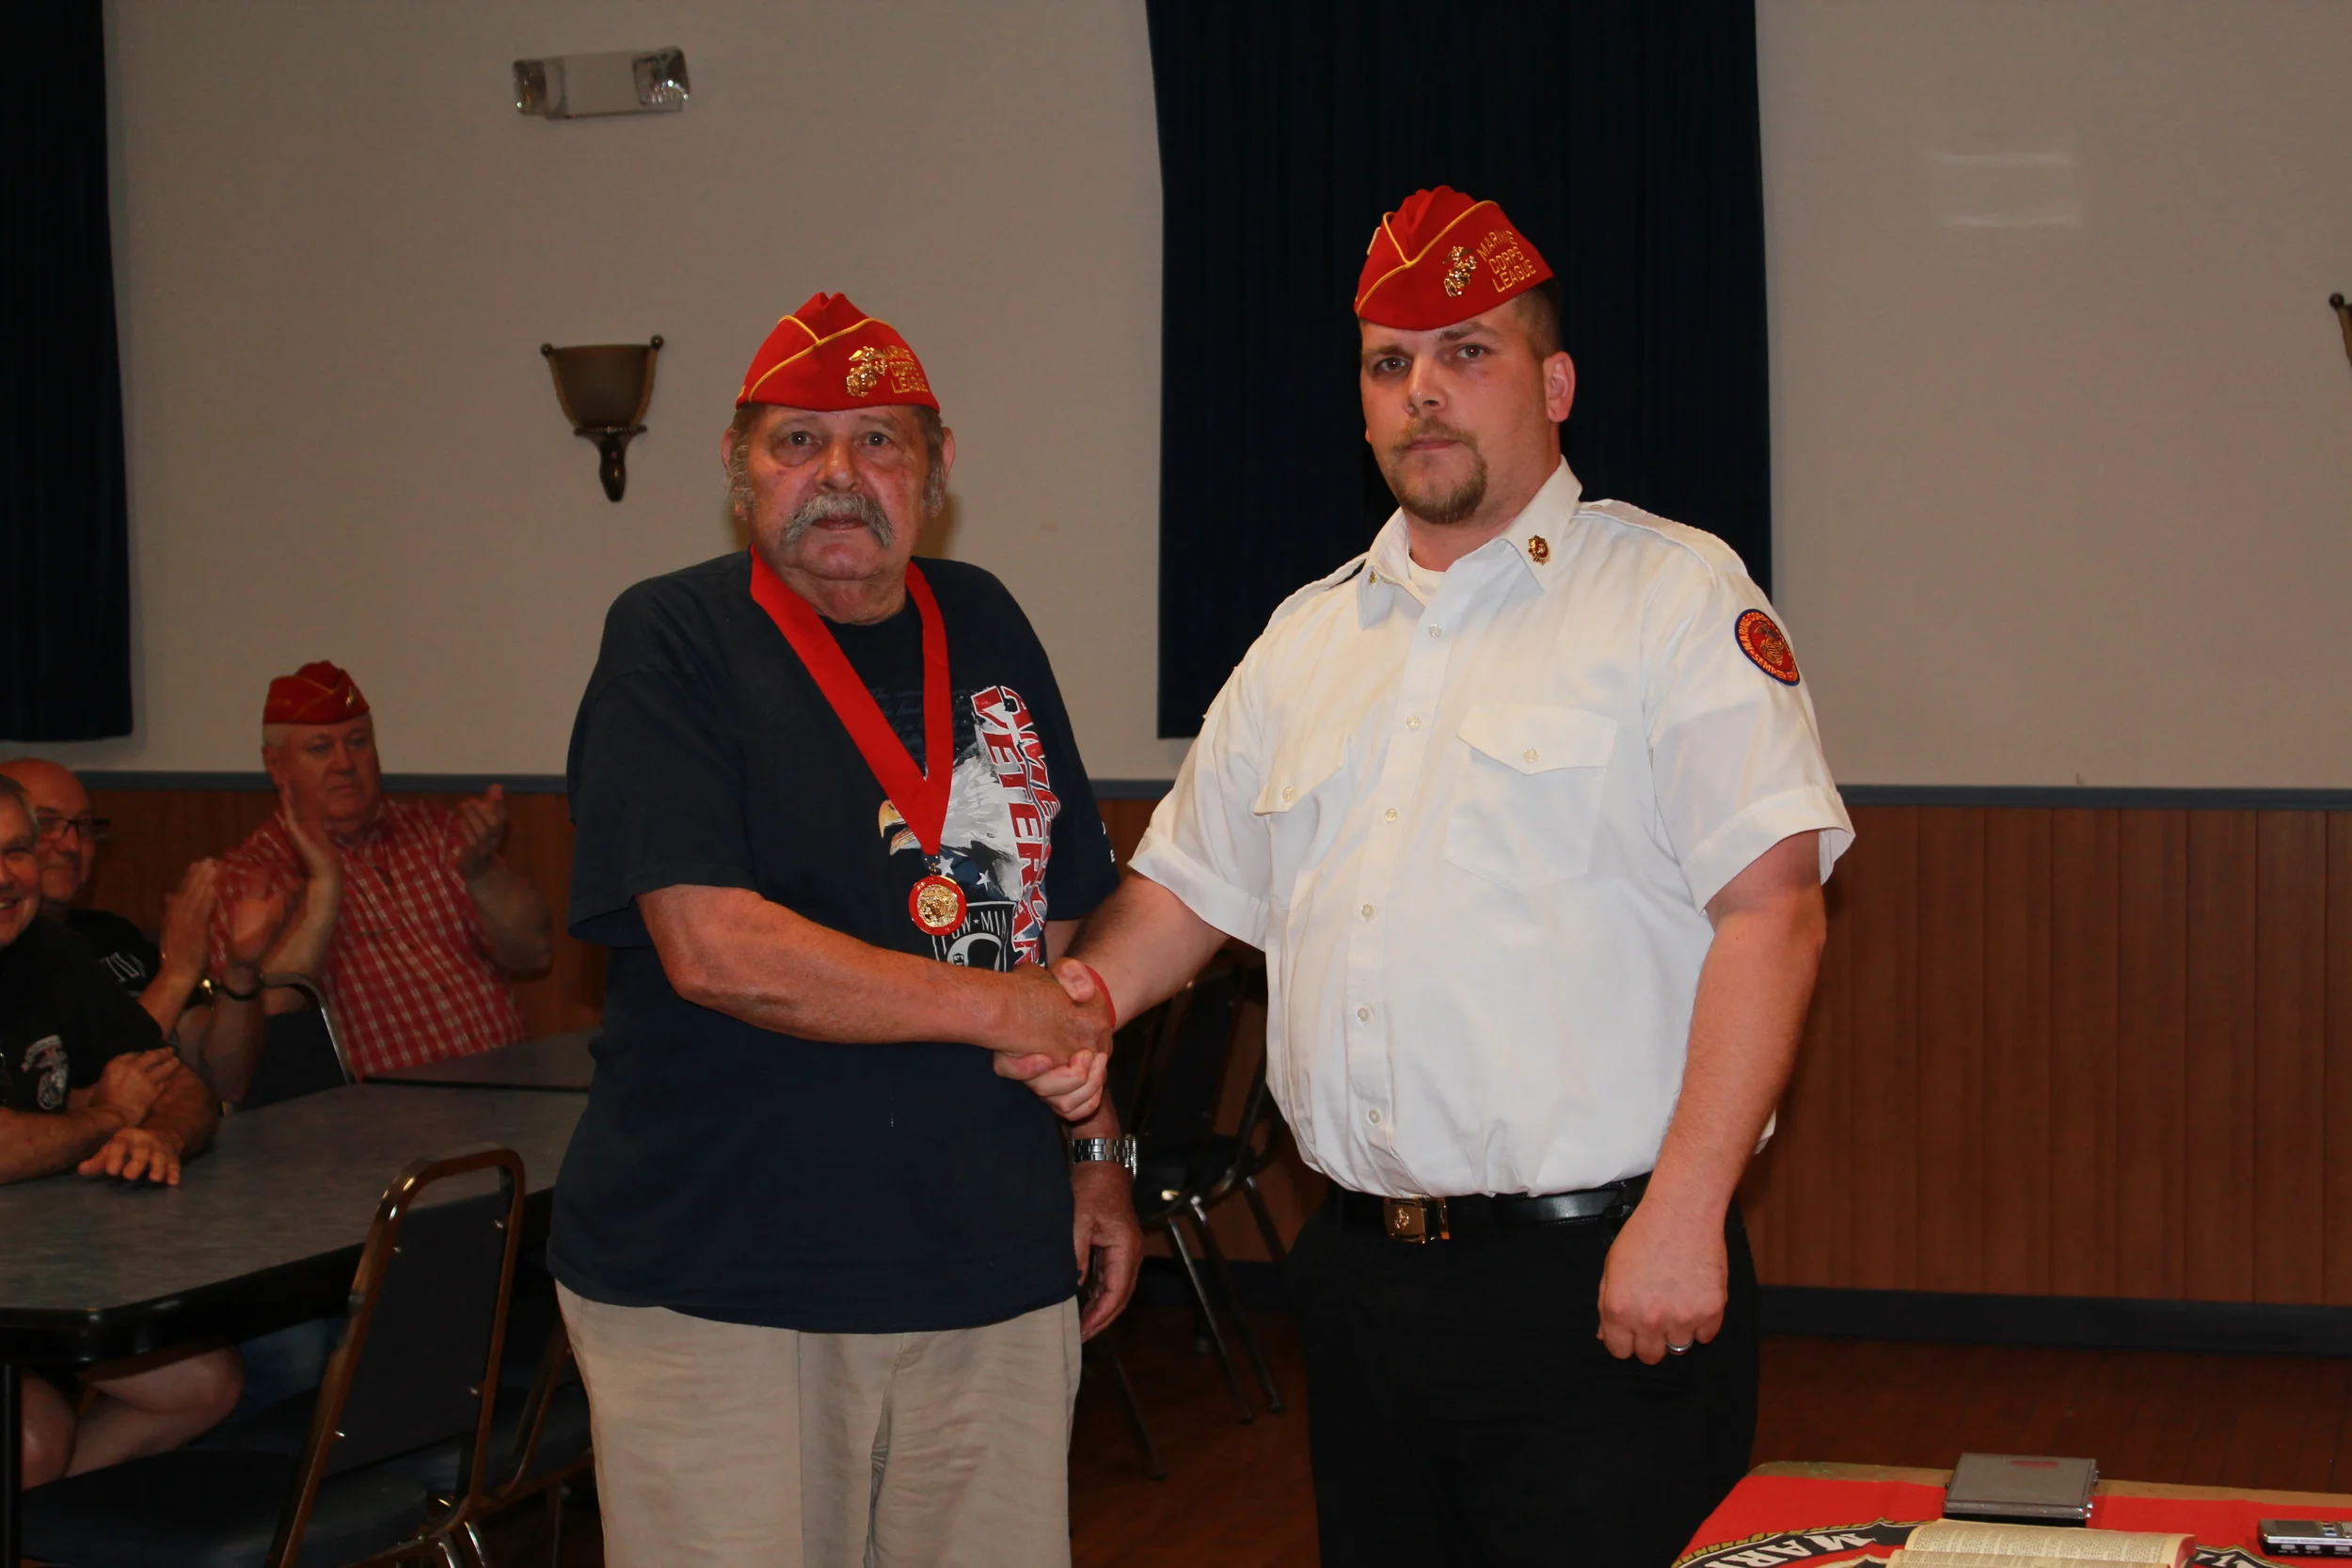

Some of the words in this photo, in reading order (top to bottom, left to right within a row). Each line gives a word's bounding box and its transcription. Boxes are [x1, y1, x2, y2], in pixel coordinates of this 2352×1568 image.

[1476, 230, 1518, 261] MARINE
[1488, 246, 1524, 274] CORPS
[1492, 260, 1536, 293] LEAGUE
